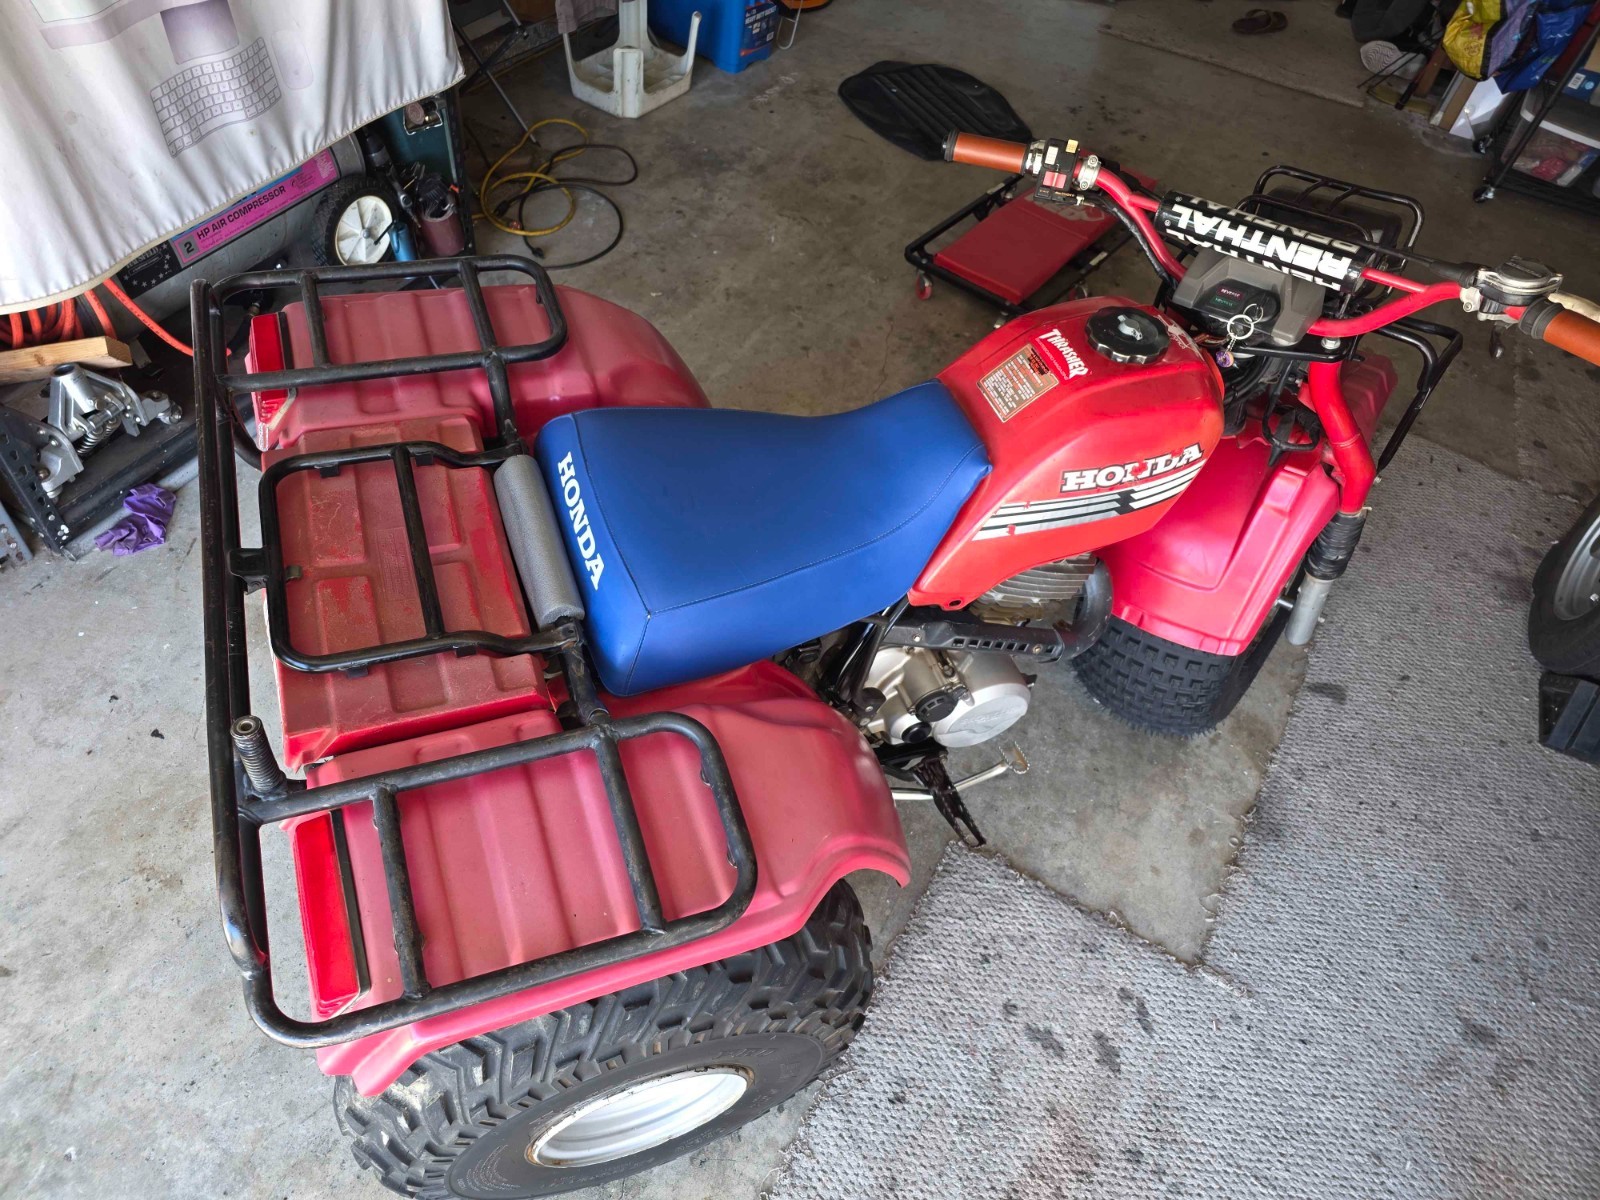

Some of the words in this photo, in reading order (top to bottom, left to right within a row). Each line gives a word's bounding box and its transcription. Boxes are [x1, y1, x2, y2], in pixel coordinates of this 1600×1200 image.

[184, 241, 195, 254] 2
[196, 226, 210, 240] HP
[211, 218, 228, 232] AIR
[227, 185, 286, 223] COMPRESSOR
[1172, 203, 1352, 280] RENTHAL
[1039, 328, 1089, 379] THRASHER
[557, 451, 605, 591] HONDA
